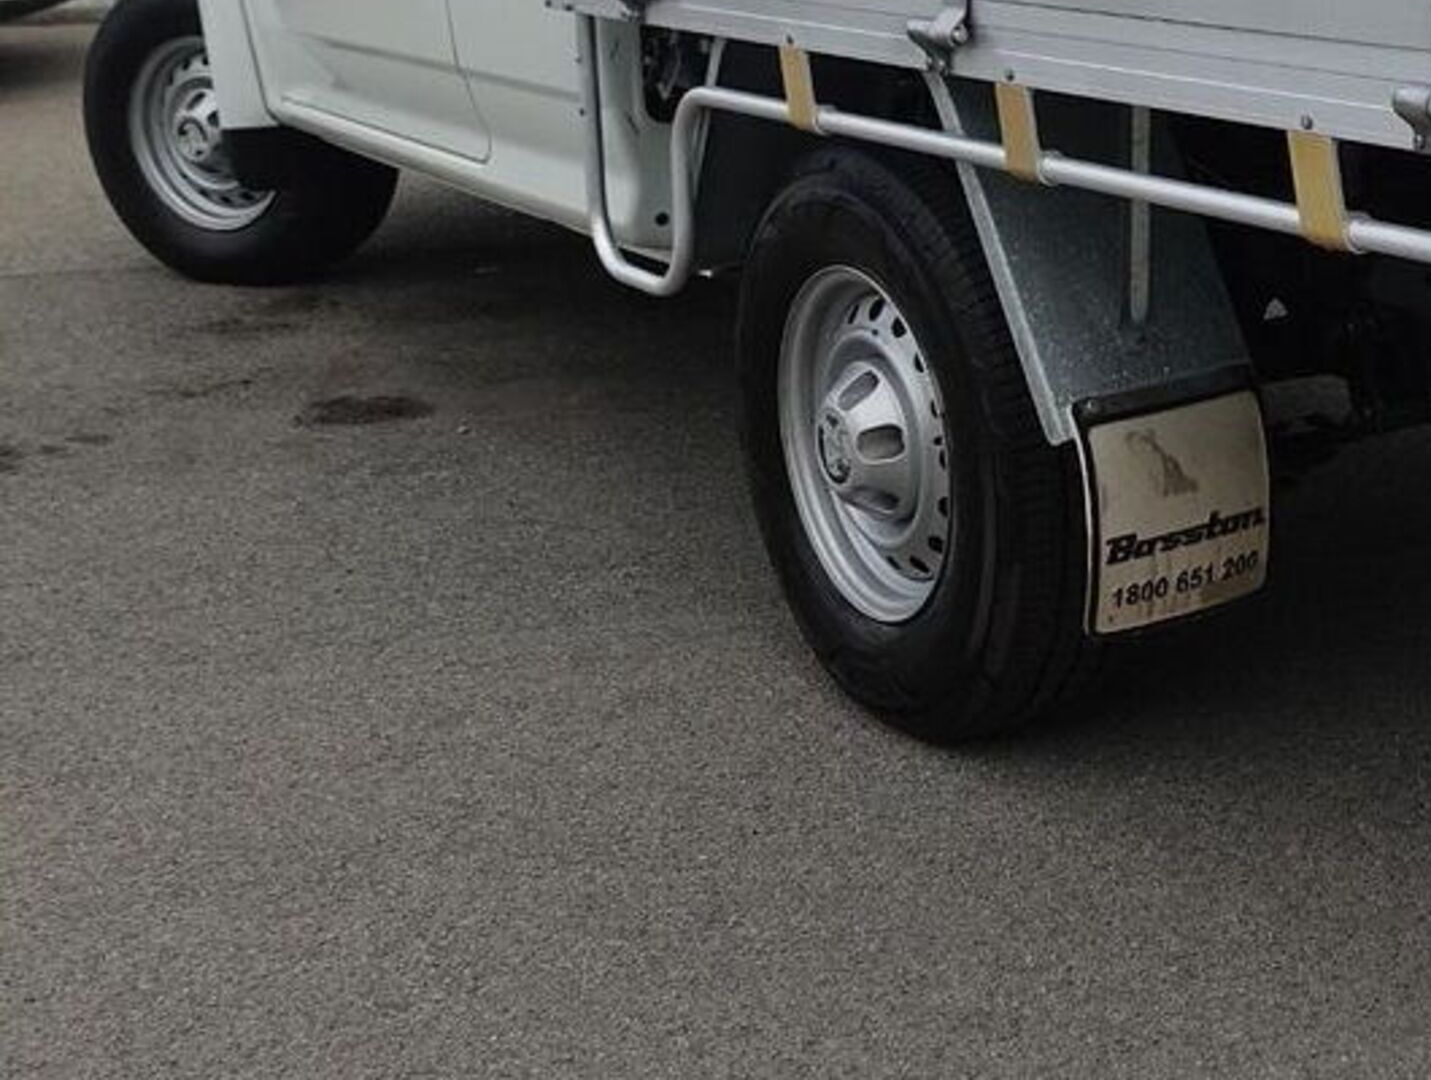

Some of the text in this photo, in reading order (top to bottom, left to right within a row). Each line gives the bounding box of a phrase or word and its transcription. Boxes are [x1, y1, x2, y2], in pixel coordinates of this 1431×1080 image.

[1113, 550, 1259, 608] 1800 651 200
